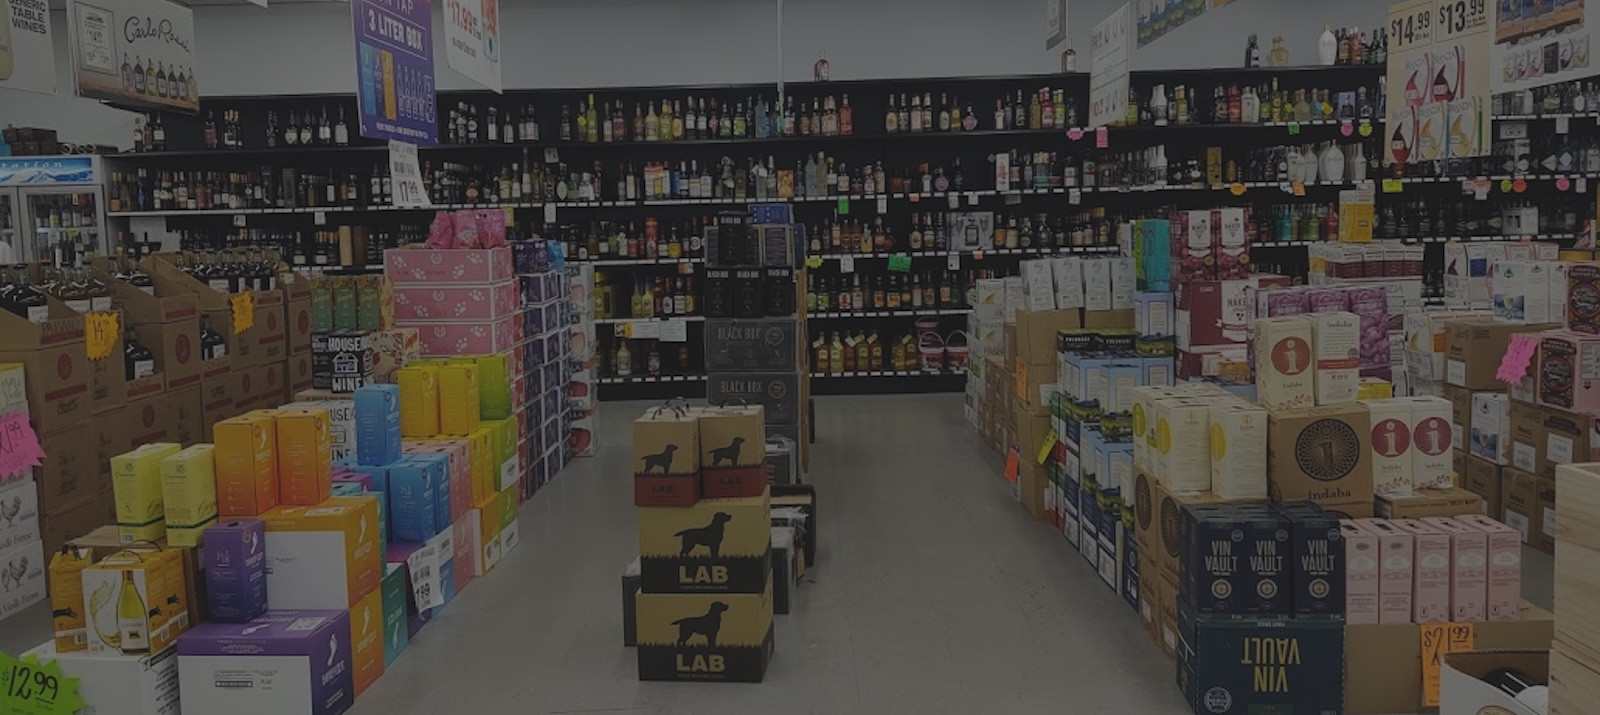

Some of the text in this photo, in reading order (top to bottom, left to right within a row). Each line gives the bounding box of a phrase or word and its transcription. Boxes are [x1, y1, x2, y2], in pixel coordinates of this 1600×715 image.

[11, 5, 45, 23] TABLE
[12, 17, 46, 34] WINES
[124, 16, 157, 43] Carlo
[368, 9, 423, 51] 3 LITER BOX
[1392, 11, 1430, 47] $14.99
[328, 337, 361, 352] HOUSE
[721, 381, 746, 393] BLACK
[652, 485, 673, 493] LAB
[720, 477, 742, 485] LAB
[1308, 488, 1350, 501] indaba
[1211, 540, 1232, 555] VIN
[1256, 540, 1276, 555] VIN
[1307, 539, 1328, 555] VIN
[1204, 556, 1238, 571] VAULT
[1250, 556, 1283, 571] VAULT
[1301, 555, 1335, 571] VAULT
[678, 565, 729, 583] LAB
[1241, 637, 1301, 664] VAULT
[676, 654, 725, 672] LAB
[2, 665, 58, 700] $12.99
[1254, 666, 1289, 692] VIN
